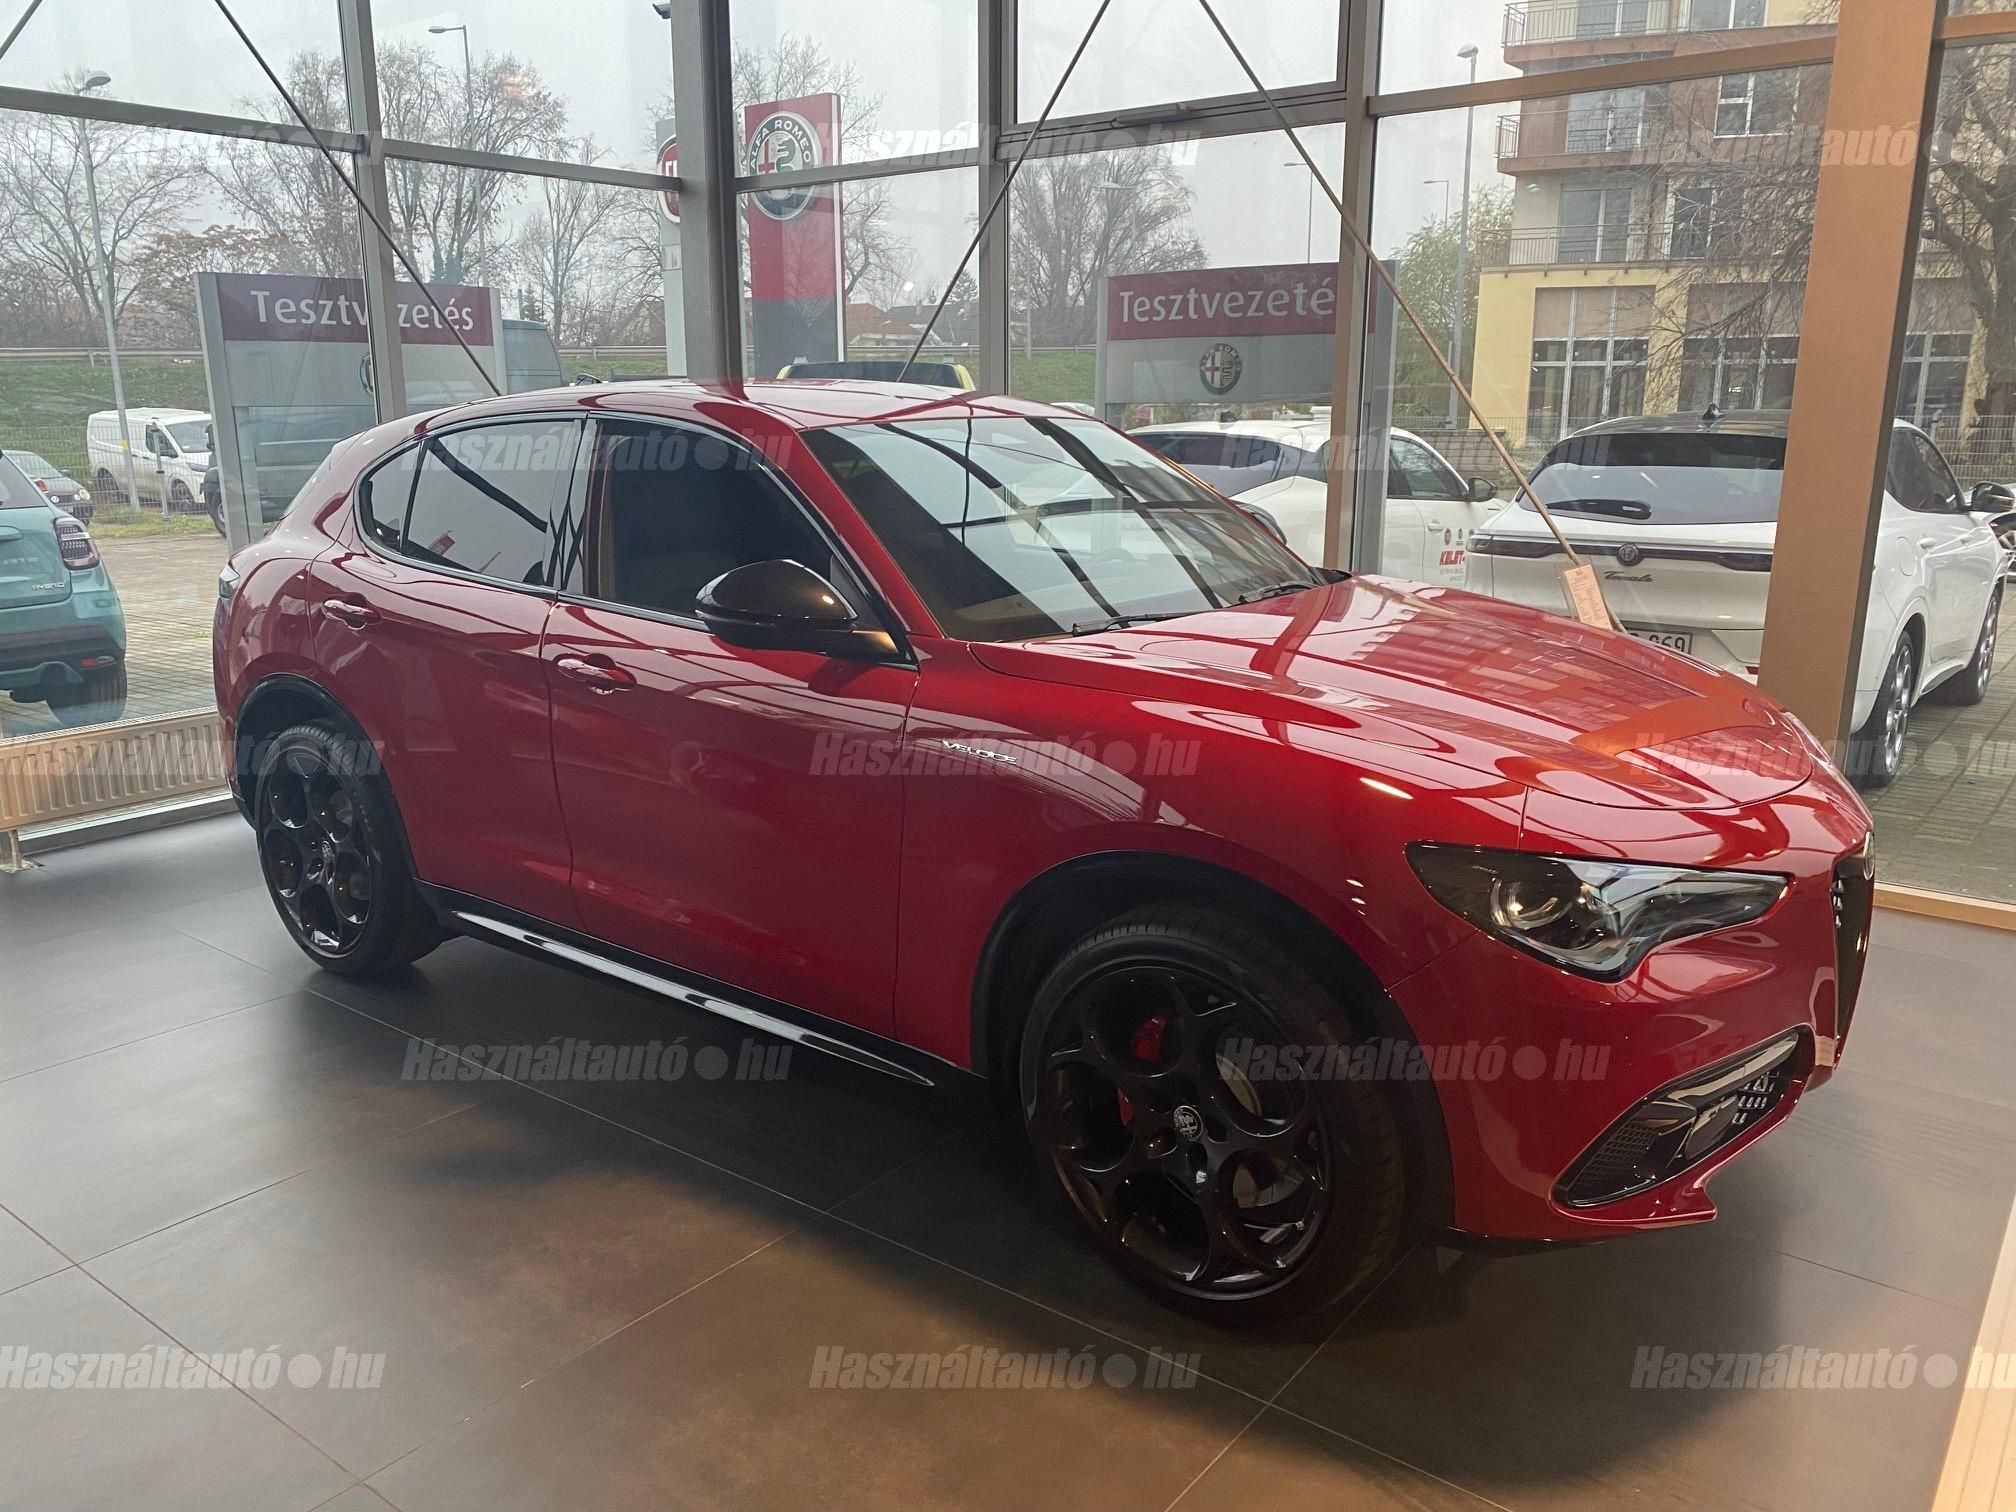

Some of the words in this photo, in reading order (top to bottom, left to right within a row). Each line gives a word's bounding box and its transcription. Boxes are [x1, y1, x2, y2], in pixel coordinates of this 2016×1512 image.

[750, 128, 769, 169] ALFA
[775, 119, 811, 163] ROMEO
[250, 290, 474, 330] Tesztvzetés
[1119, 277, 1336, 322] Tesztvezeté
[943, 740, 1017, 764] VELOCE
